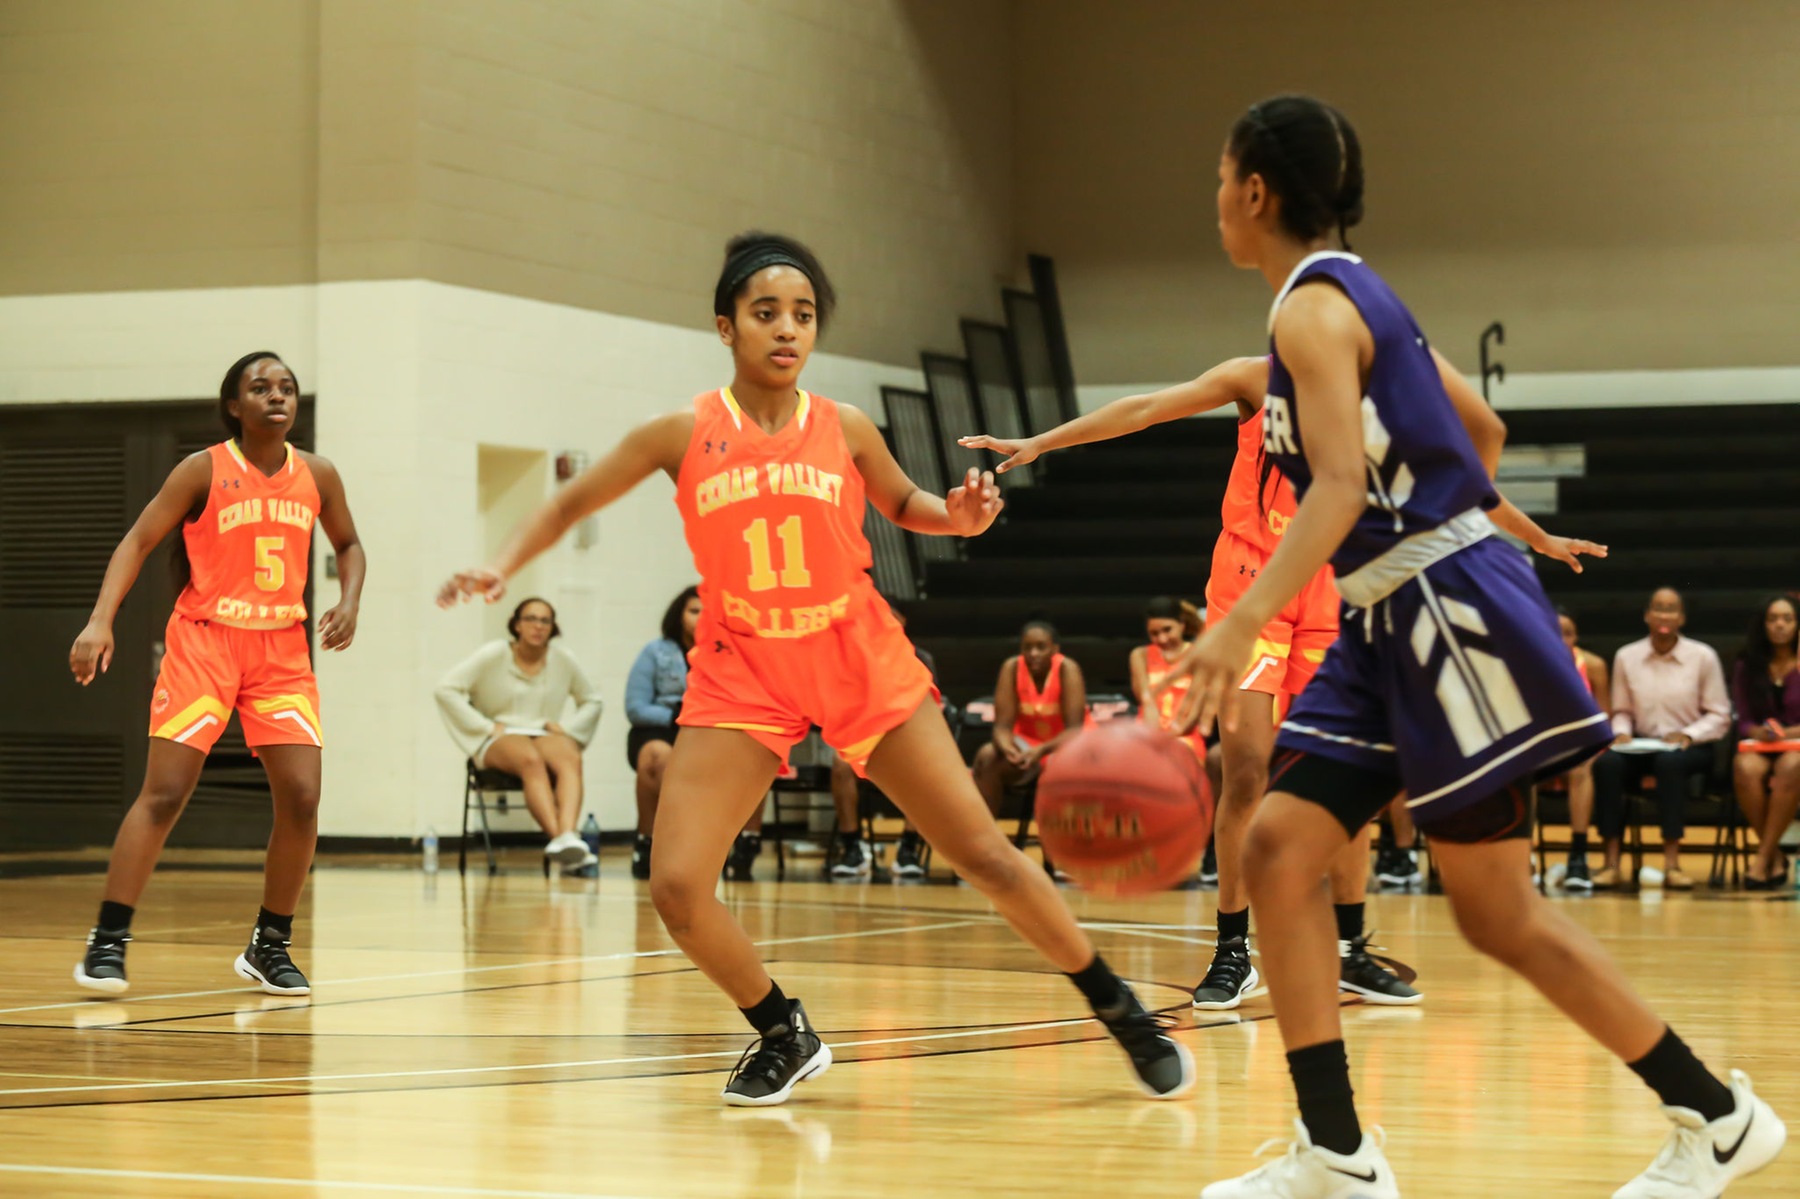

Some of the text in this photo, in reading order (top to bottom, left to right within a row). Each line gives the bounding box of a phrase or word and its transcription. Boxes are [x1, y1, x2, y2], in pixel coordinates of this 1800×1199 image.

[218, 498, 262, 534] CEDAR
[696, 463, 843, 517] CEDAR VALLEY
[255, 537, 285, 591] 5
[743, 515, 811, 591] 11
